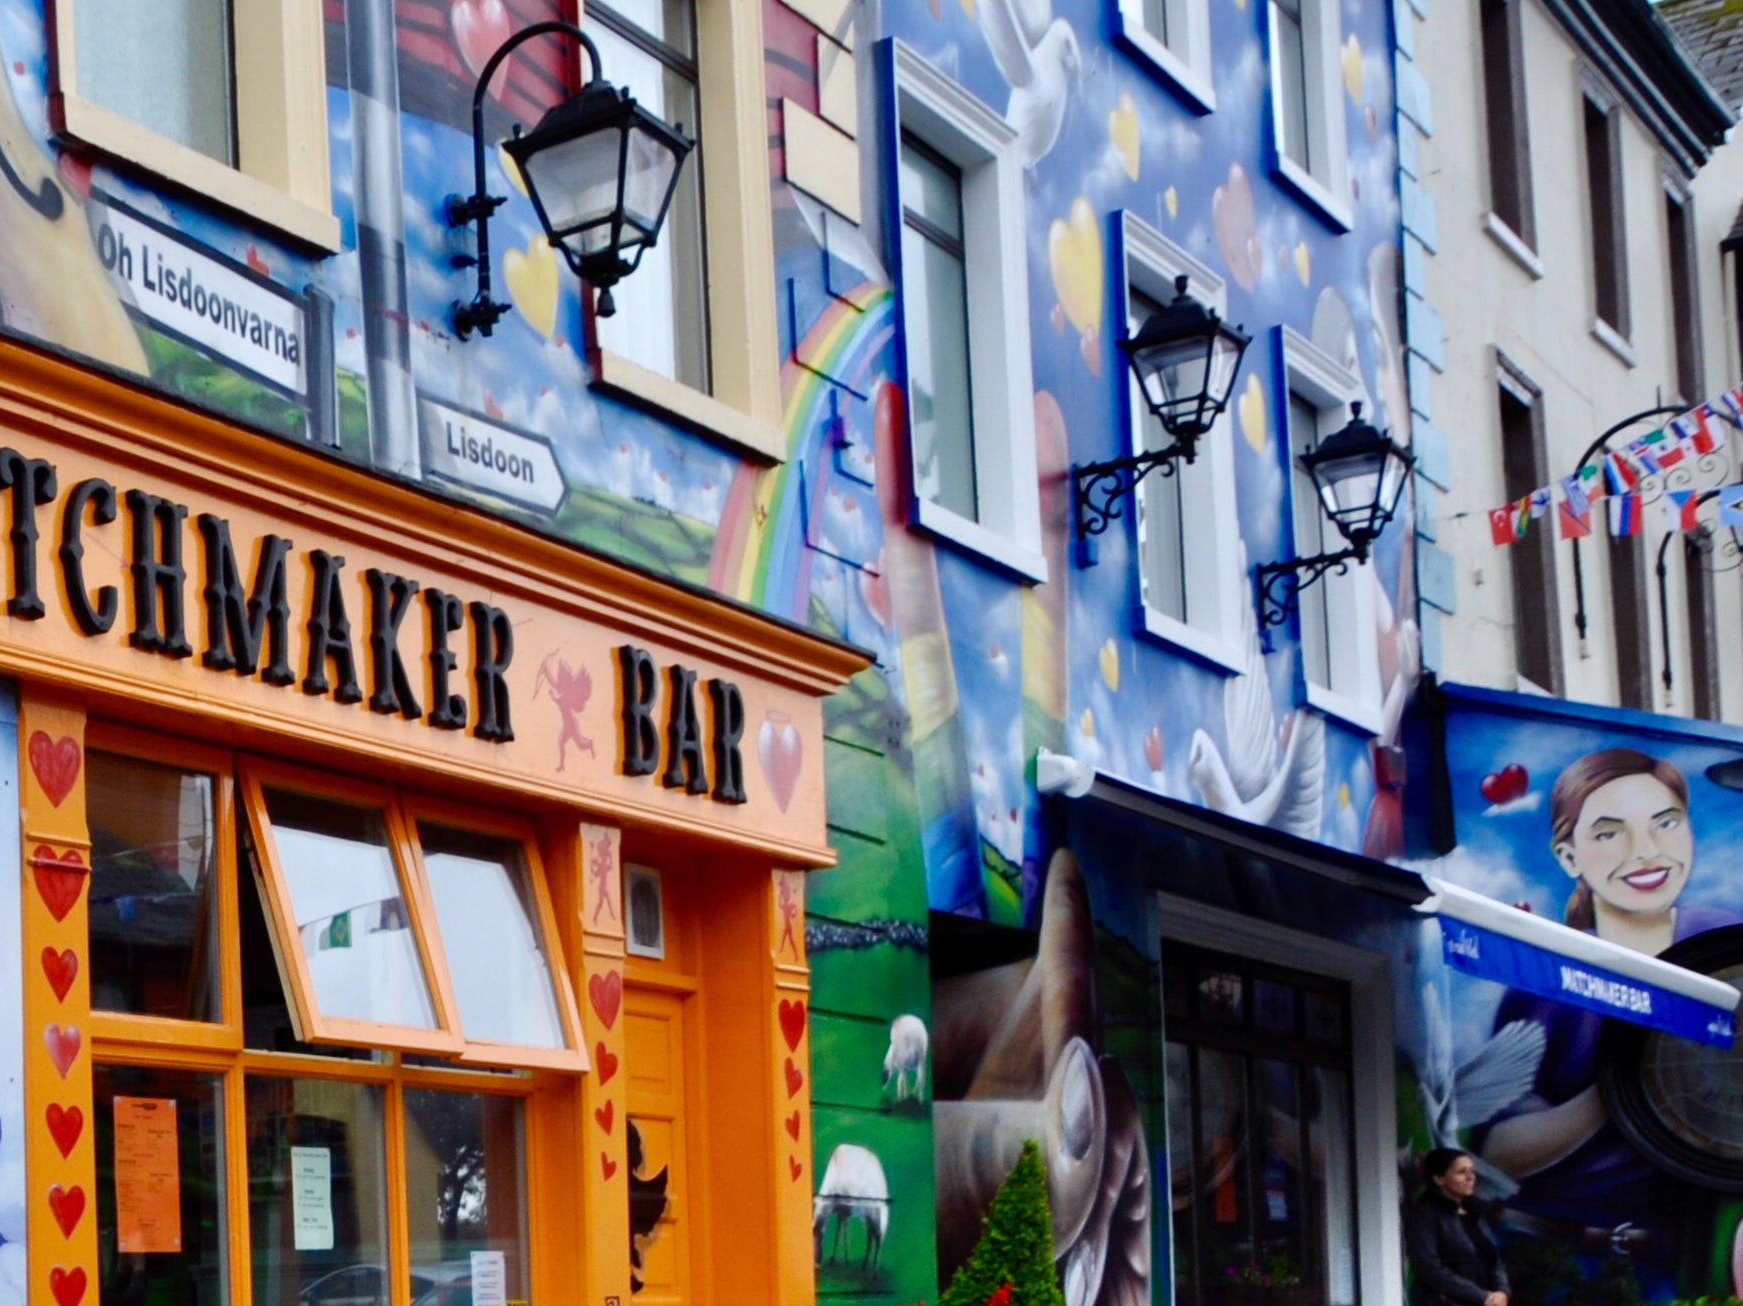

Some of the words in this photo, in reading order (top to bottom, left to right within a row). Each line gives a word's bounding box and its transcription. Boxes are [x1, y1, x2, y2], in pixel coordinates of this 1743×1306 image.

[98, 223, 133, 281] Oh
[142, 245, 300, 366] Lisdoonvarna
[446, 421, 534, 483] Lisdoon
[618, 644, 748, 806] BAR
